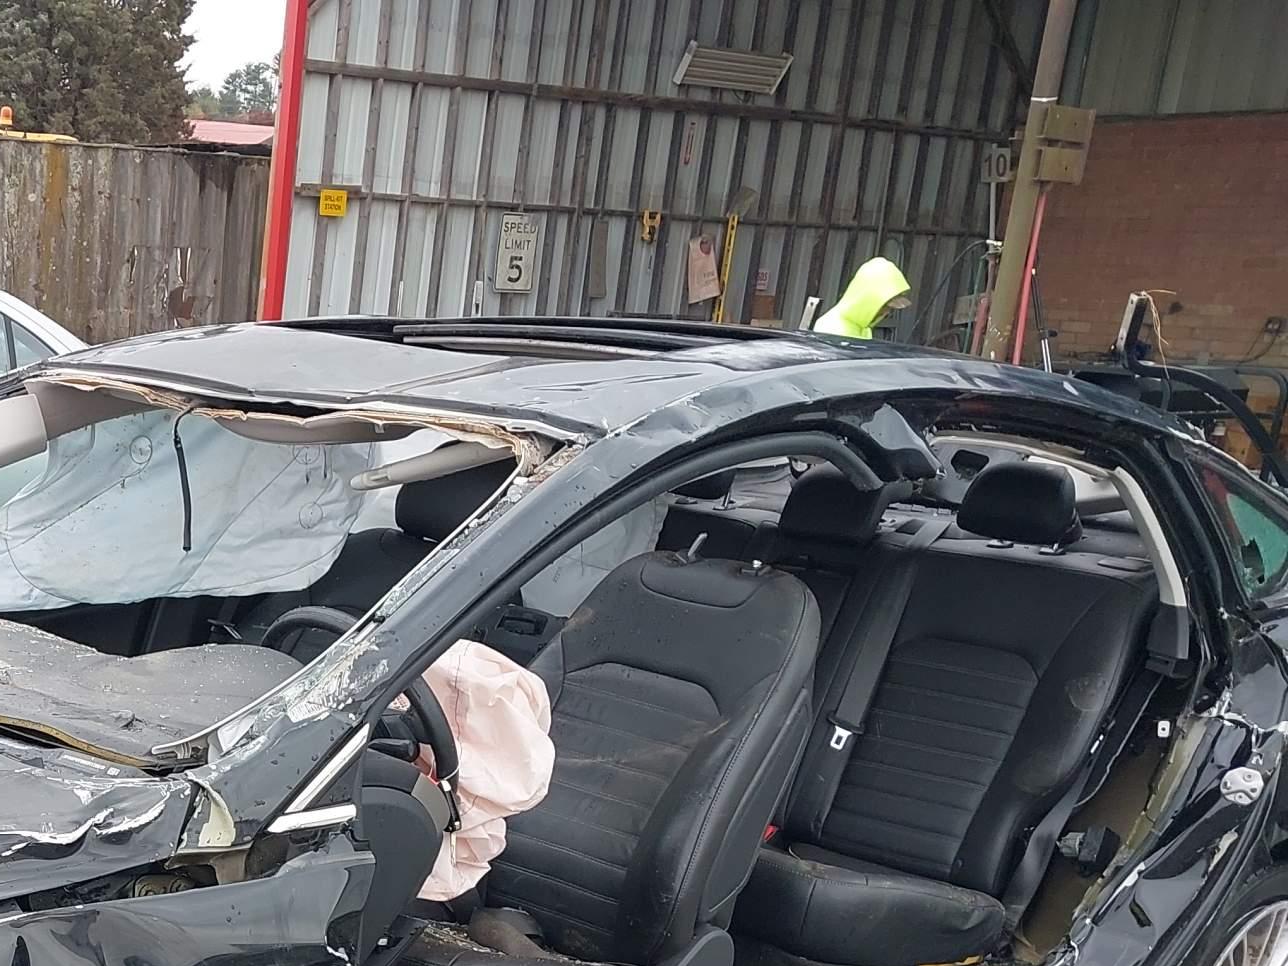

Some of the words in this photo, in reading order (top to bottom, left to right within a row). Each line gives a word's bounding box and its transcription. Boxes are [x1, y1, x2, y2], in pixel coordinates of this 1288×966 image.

[984, 153, 1007, 178] 10
[503, 222, 537, 234] SPEED
[504, 238, 532, 251] LIMIT
[507, 255, 524, 283] 5
